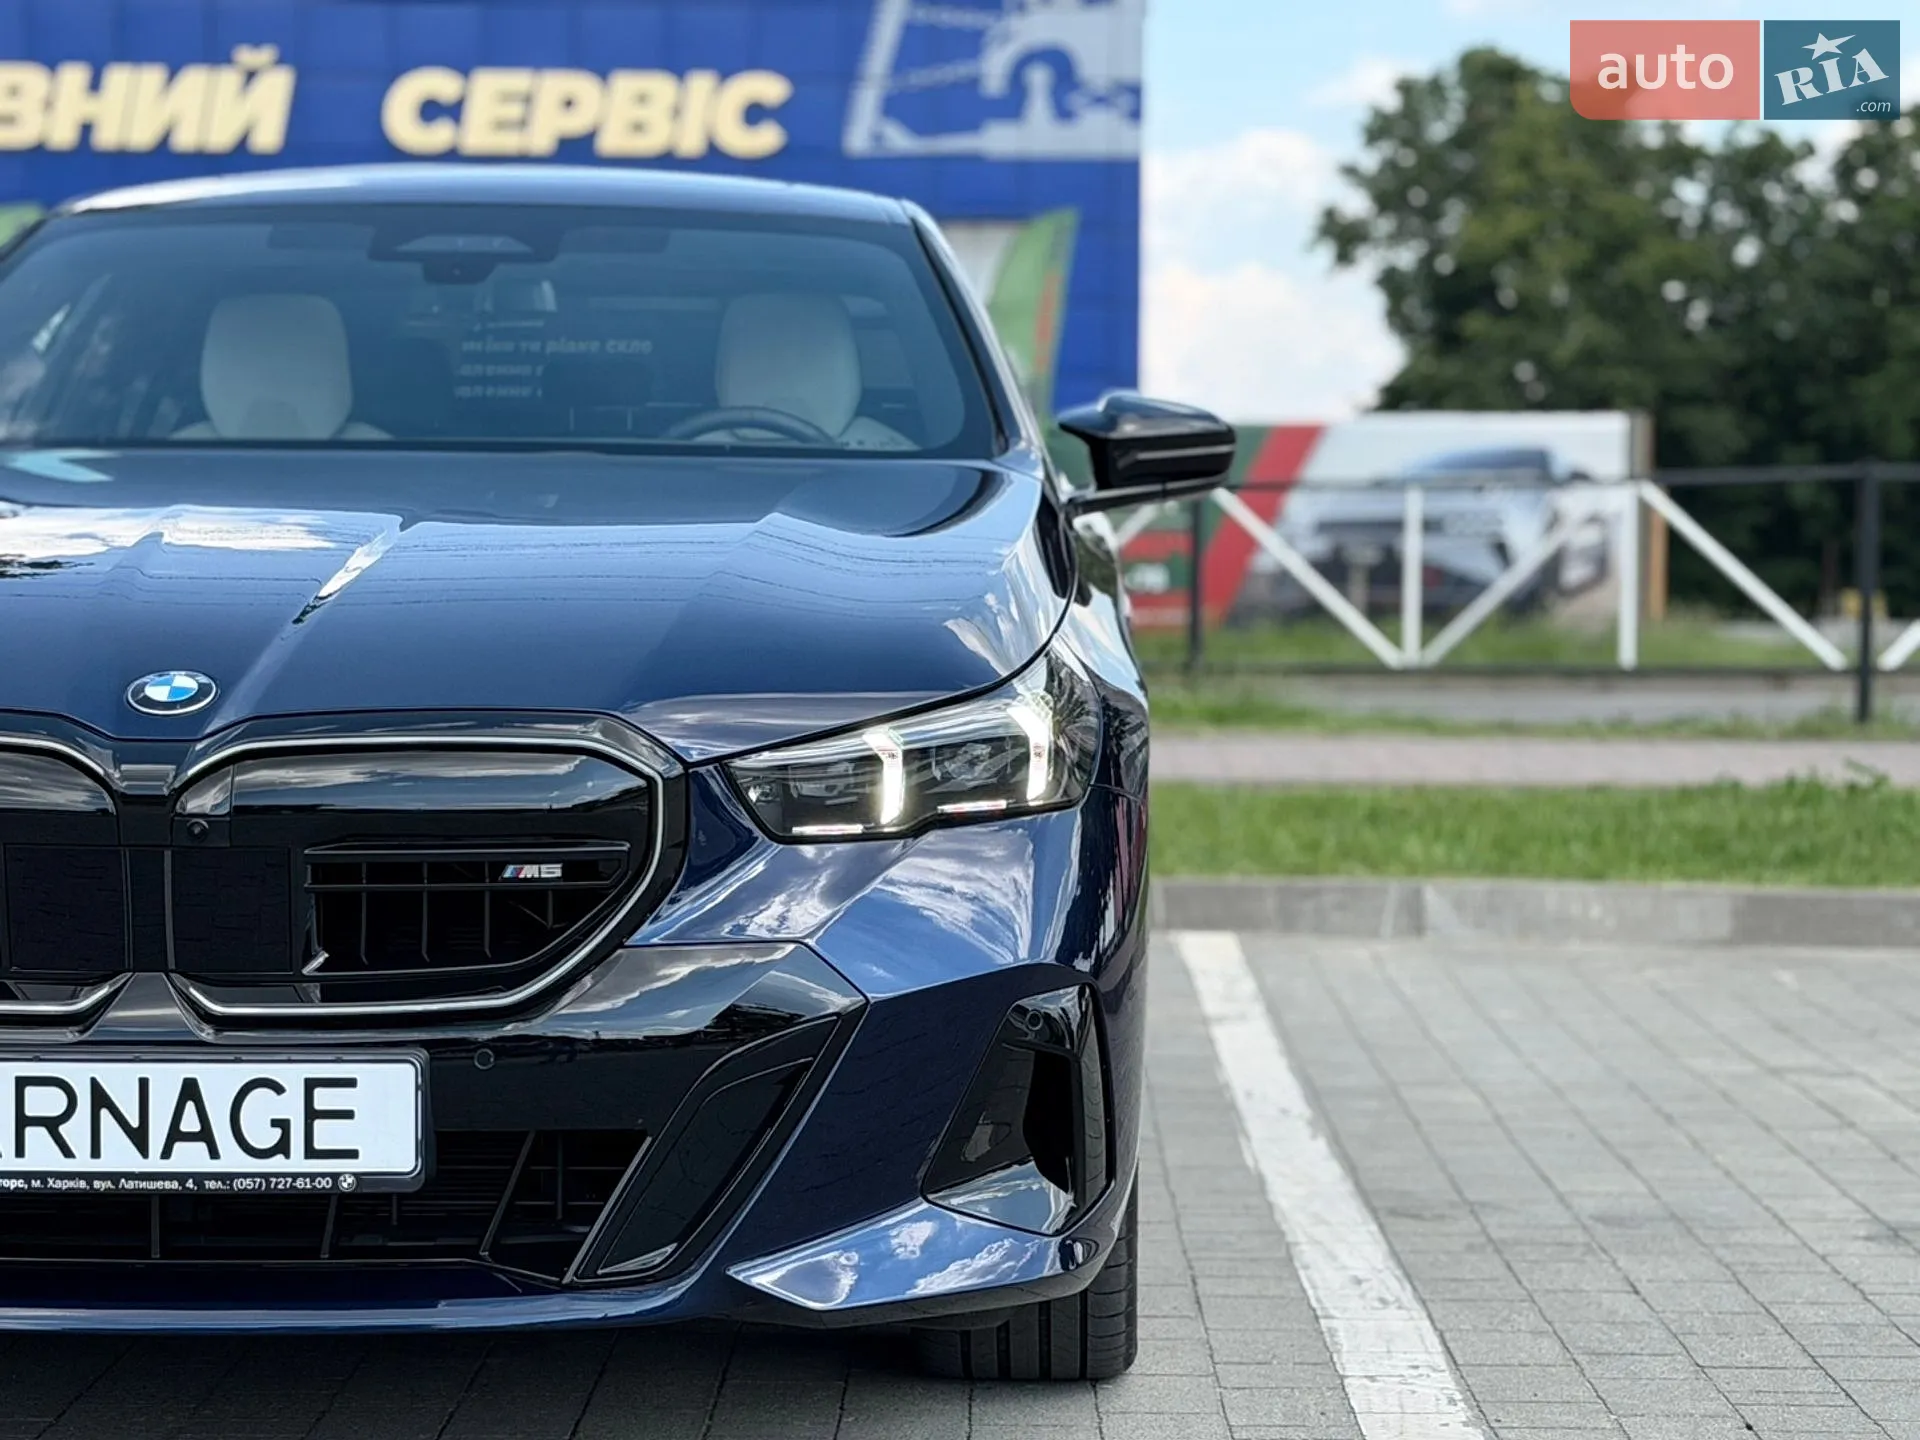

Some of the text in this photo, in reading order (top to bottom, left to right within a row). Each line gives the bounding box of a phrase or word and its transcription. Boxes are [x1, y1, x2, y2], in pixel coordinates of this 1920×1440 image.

[380, 65, 794, 159] СЕРВІС
[517, 863, 563, 879] M5
[0, 1075, 360, 1161] RNAGE
[31, 1178, 44, 1189] м.
[47, 1177, 90, 1190] Харків,
[93, 1178, 116, 1191] вул.
[118, 1177, 183, 1191] Латишева,
[185, 1177, 198, 1190] 4,
[233, 1177, 266, 1191] (057)
[269, 1177, 332, 1190] 727-61-00
